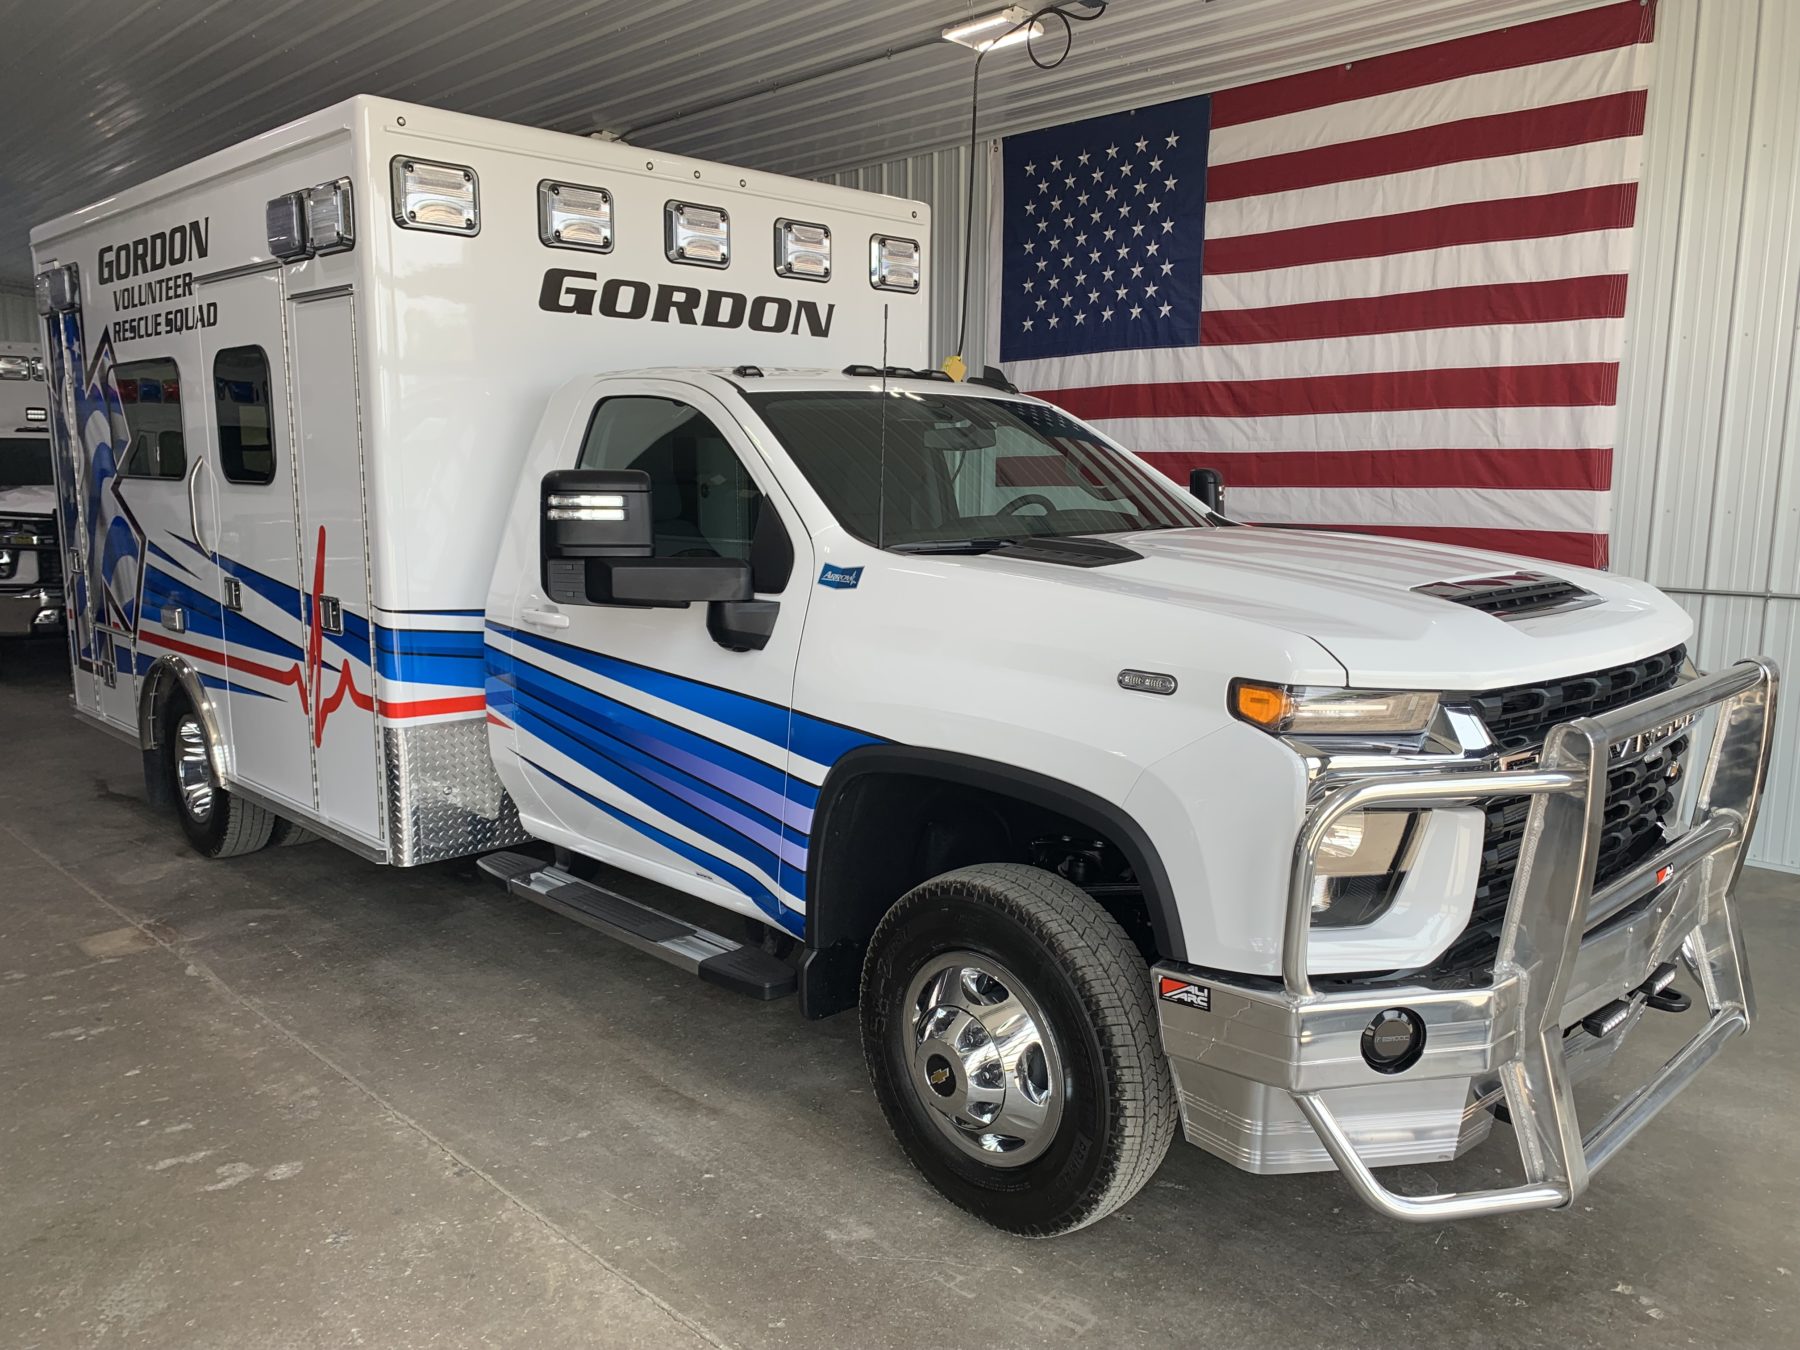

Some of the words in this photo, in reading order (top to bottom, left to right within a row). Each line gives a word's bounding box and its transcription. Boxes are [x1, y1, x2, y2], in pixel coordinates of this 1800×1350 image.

[98, 216, 209, 285] GORDON
[113, 272, 193, 312] VOLUNTEER
[538, 267, 836, 338] GORDON
[113, 314, 162, 343] RESCUE
[165, 302, 218, 335] SQUAD
[1163, 985, 1208, 998] ALI
[1172, 992, 1208, 1007] ARC
